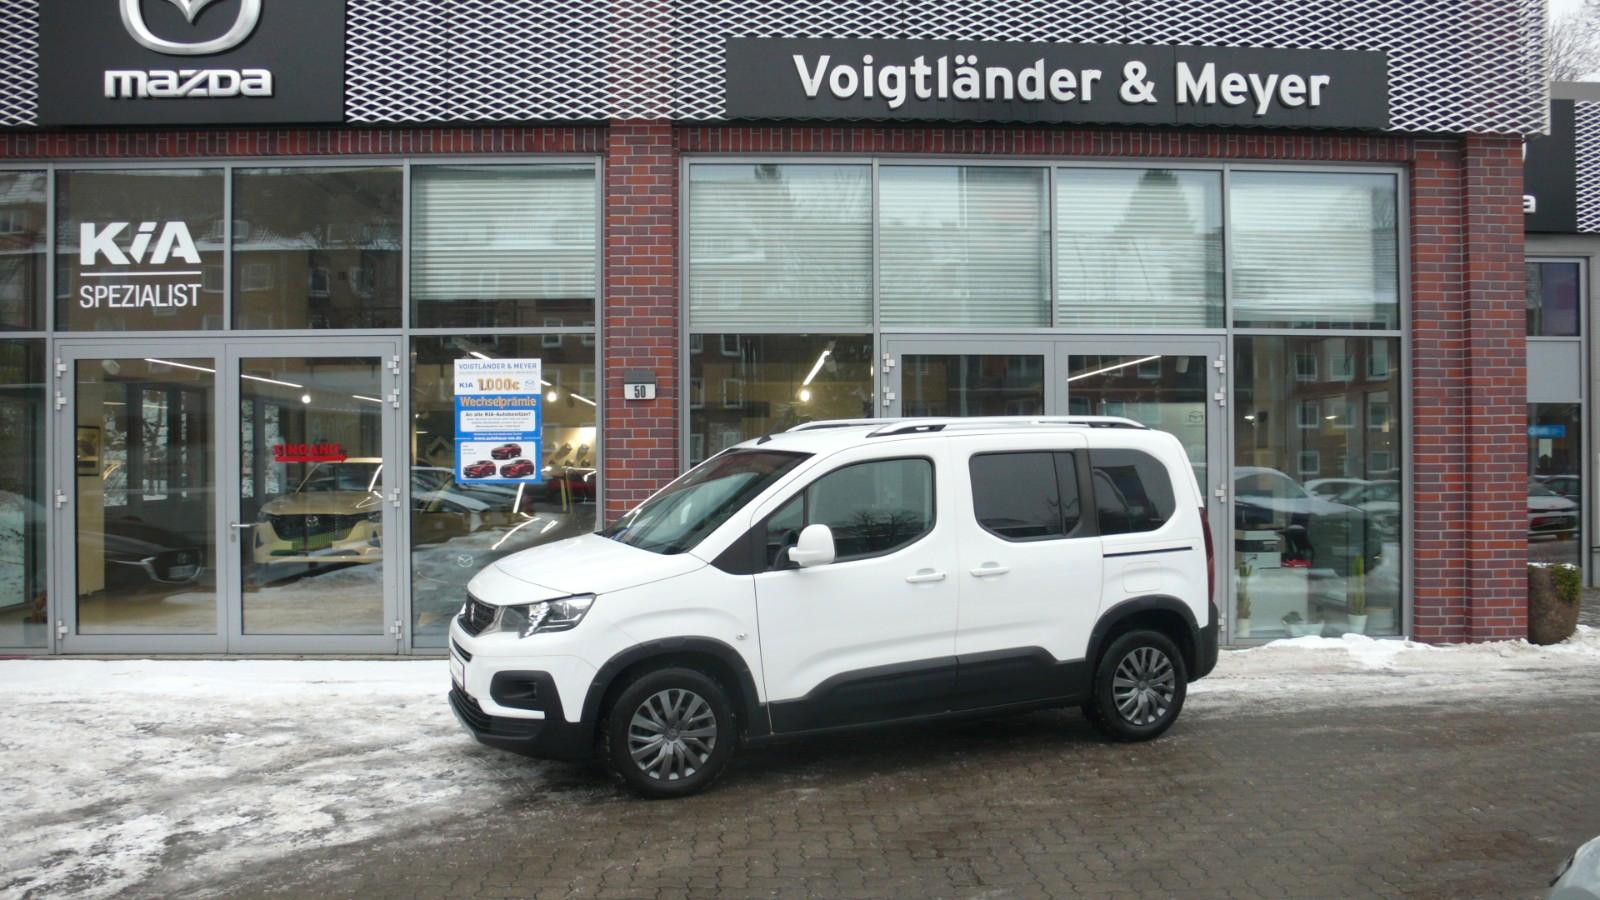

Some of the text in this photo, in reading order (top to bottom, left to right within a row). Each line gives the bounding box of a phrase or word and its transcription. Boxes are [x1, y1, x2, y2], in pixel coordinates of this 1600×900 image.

[104, 69, 272, 98] mazda
[792, 54, 1330, 115] Voigtländer & Meyer
[80, 284, 202, 308] SPEZIALIST
[461, 397, 536, 408] Wechselprämie
[634, 385, 646, 398] 50
